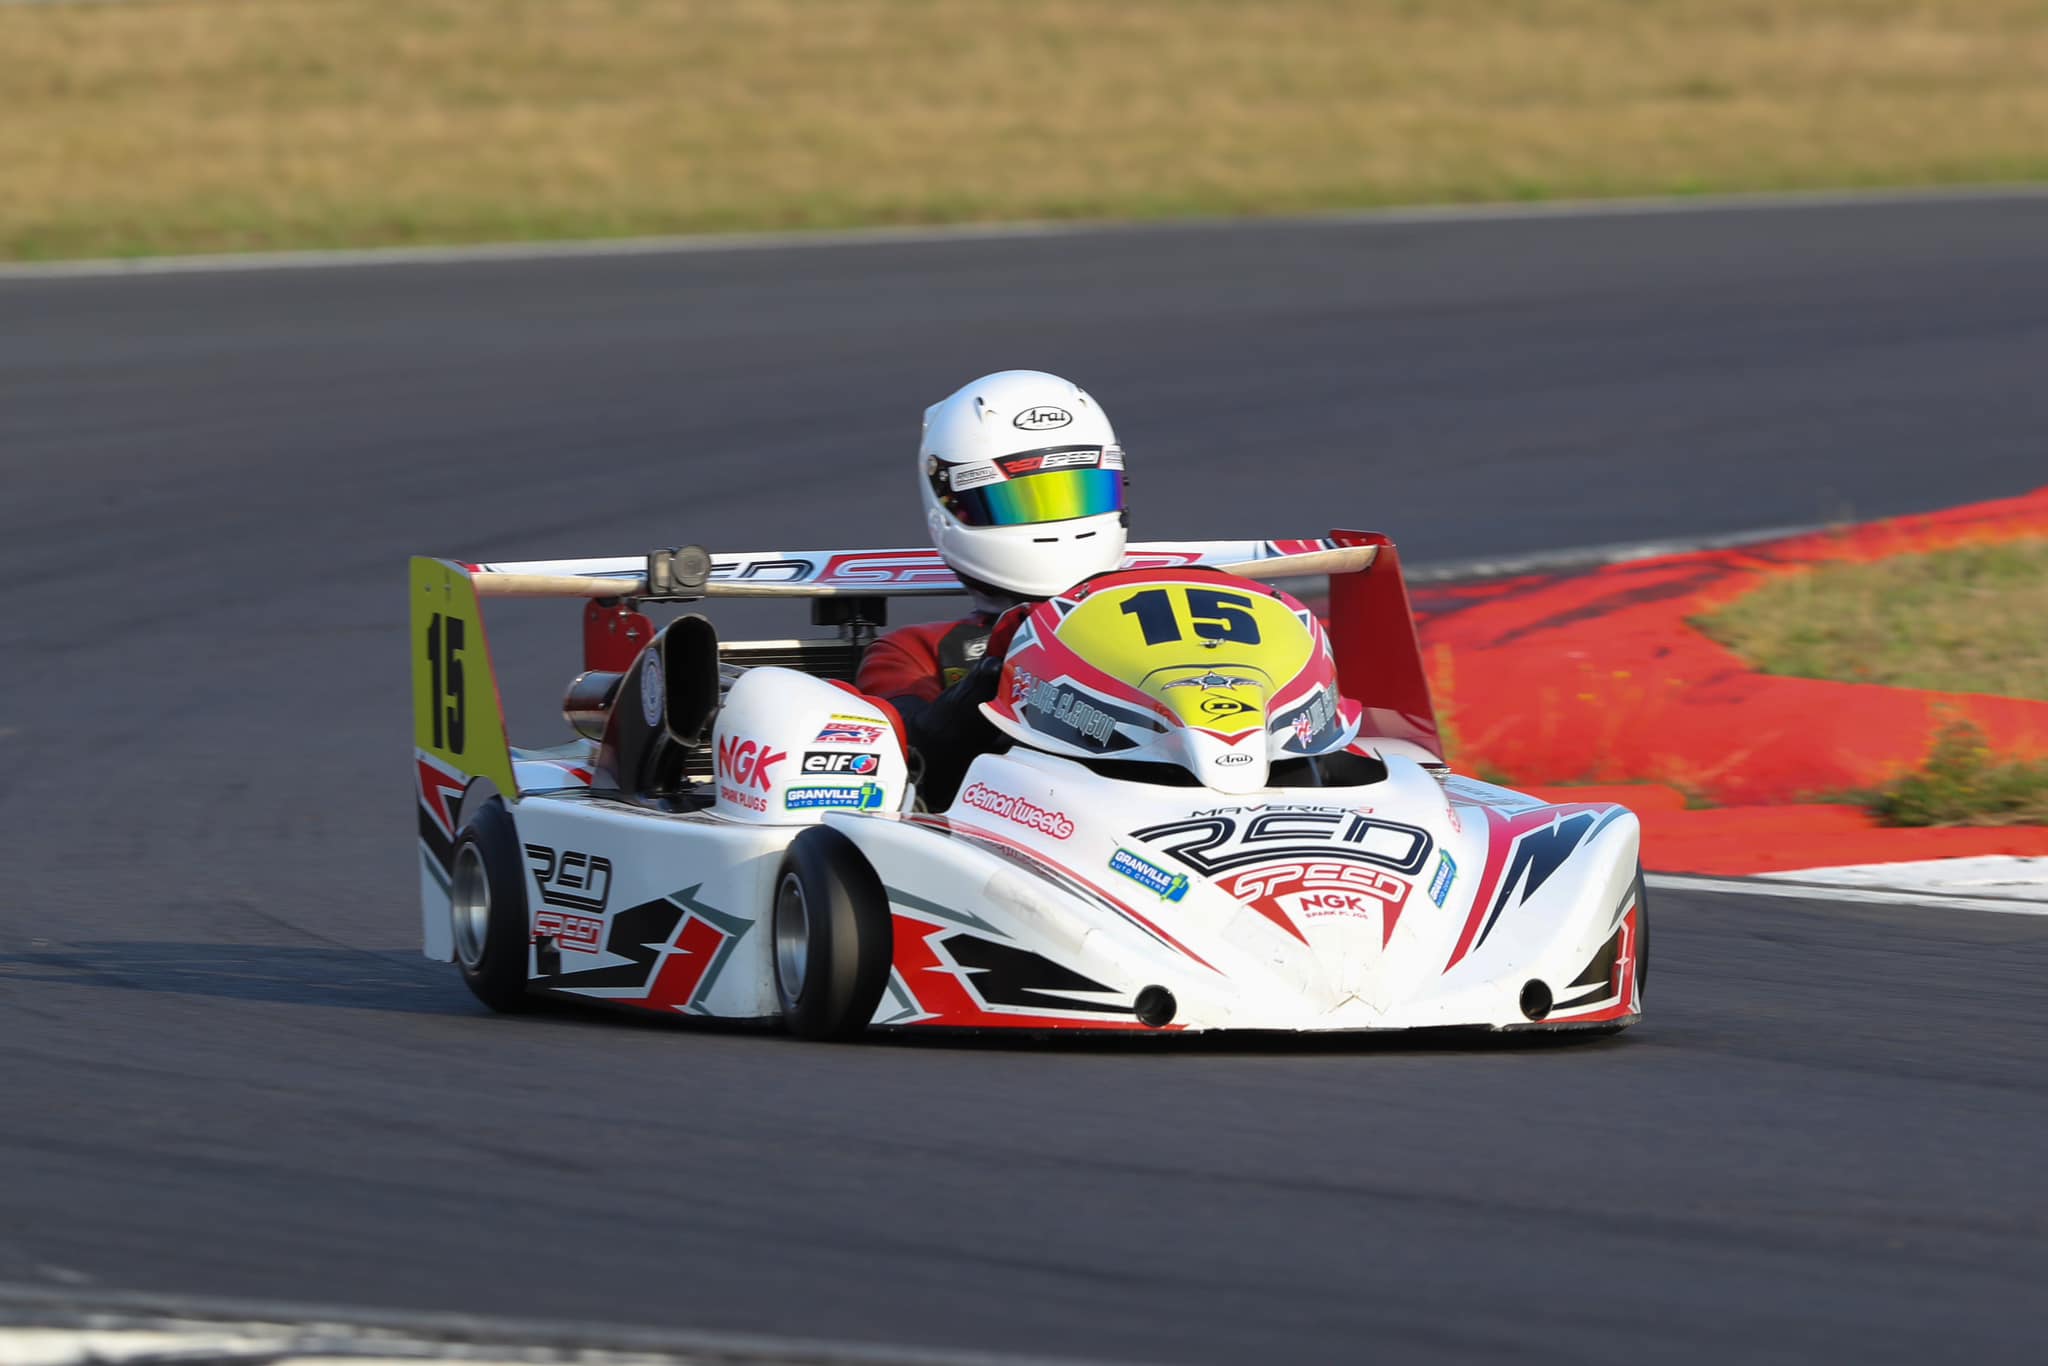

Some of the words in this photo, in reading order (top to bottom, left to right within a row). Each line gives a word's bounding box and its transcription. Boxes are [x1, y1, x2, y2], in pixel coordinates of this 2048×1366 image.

[1015, 408, 1068, 426] Arai
[1120, 588, 1261, 646] 15
[428, 612, 465, 755] 15
[719, 733, 787, 792] NGK
[804, 754, 852, 772] elf
[787, 789, 860, 801] GRANVILLE
[787, 799, 813, 807] AUTO
[963, 783, 1014, 819] demon
[1010, 797, 1075, 840] tweeks
[1110, 860, 1133, 875] AUTO
[1114, 850, 1173, 887] GRANVILLE
[1233, 865, 1407, 905] SPEED
[1299, 894, 1367, 911] NGK
